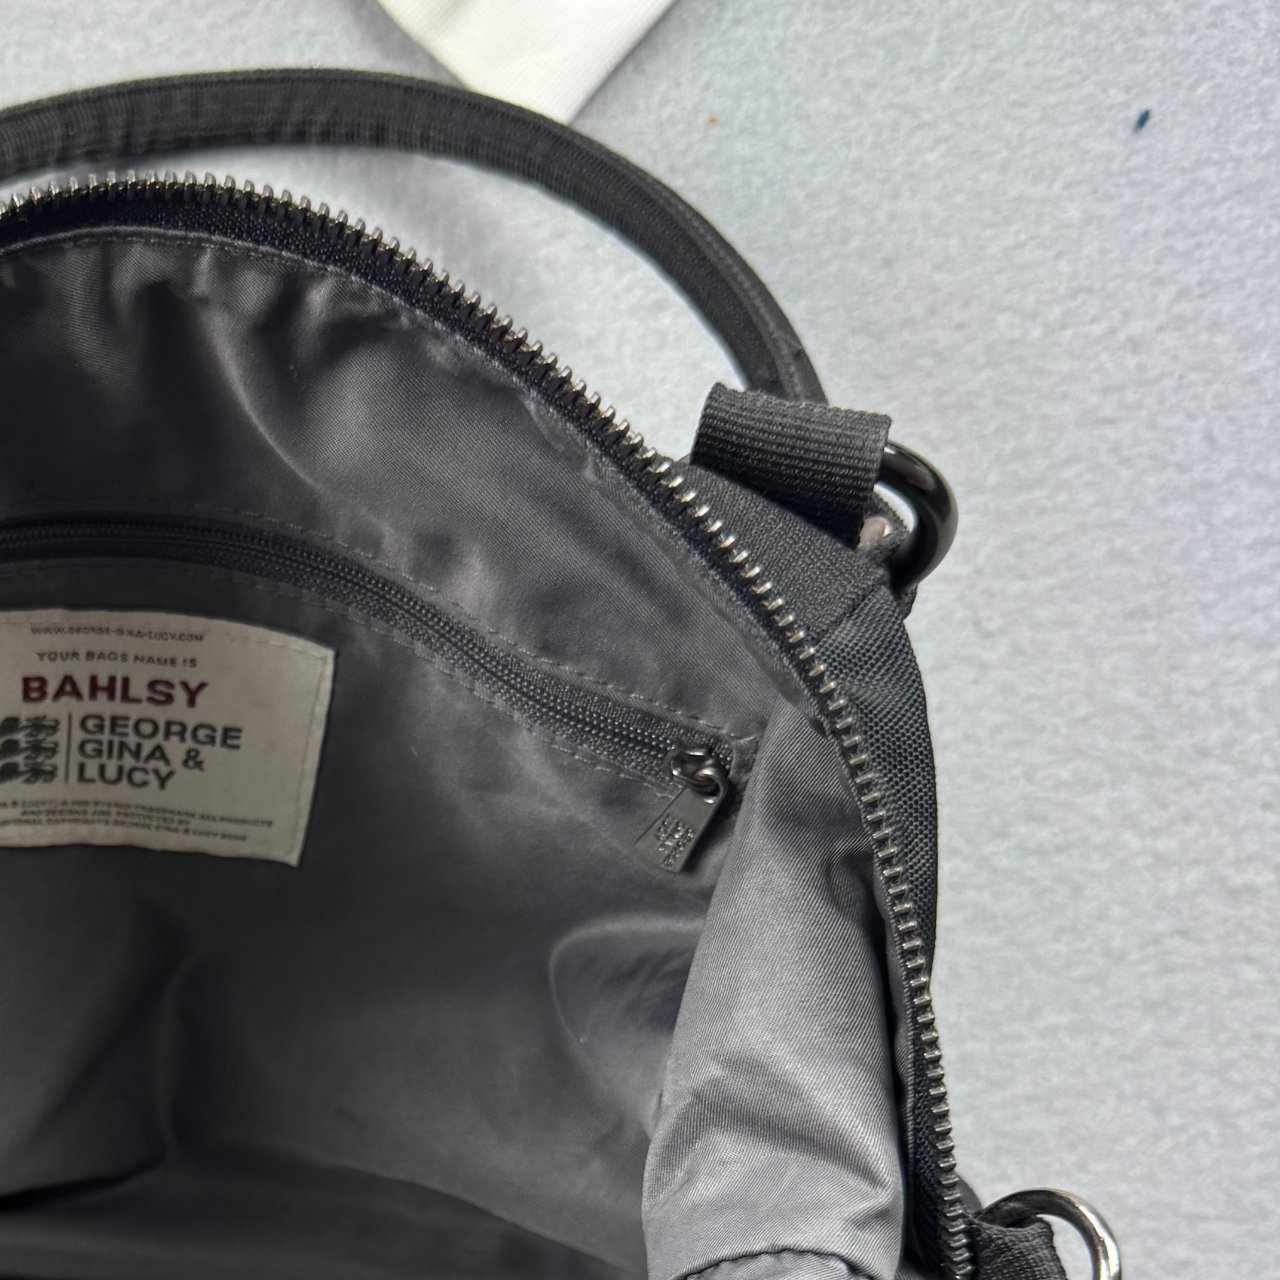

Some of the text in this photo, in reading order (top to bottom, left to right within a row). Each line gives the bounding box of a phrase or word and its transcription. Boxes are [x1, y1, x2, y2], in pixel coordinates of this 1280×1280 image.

[36, 651, 198, 669] YOUR BAGS NAME IS
[22, 674, 209, 708] BAHLSY
[79, 714, 243, 750] GEORGE
[78, 739, 205, 772] GINA &
[77, 762, 177, 791] LUCY
